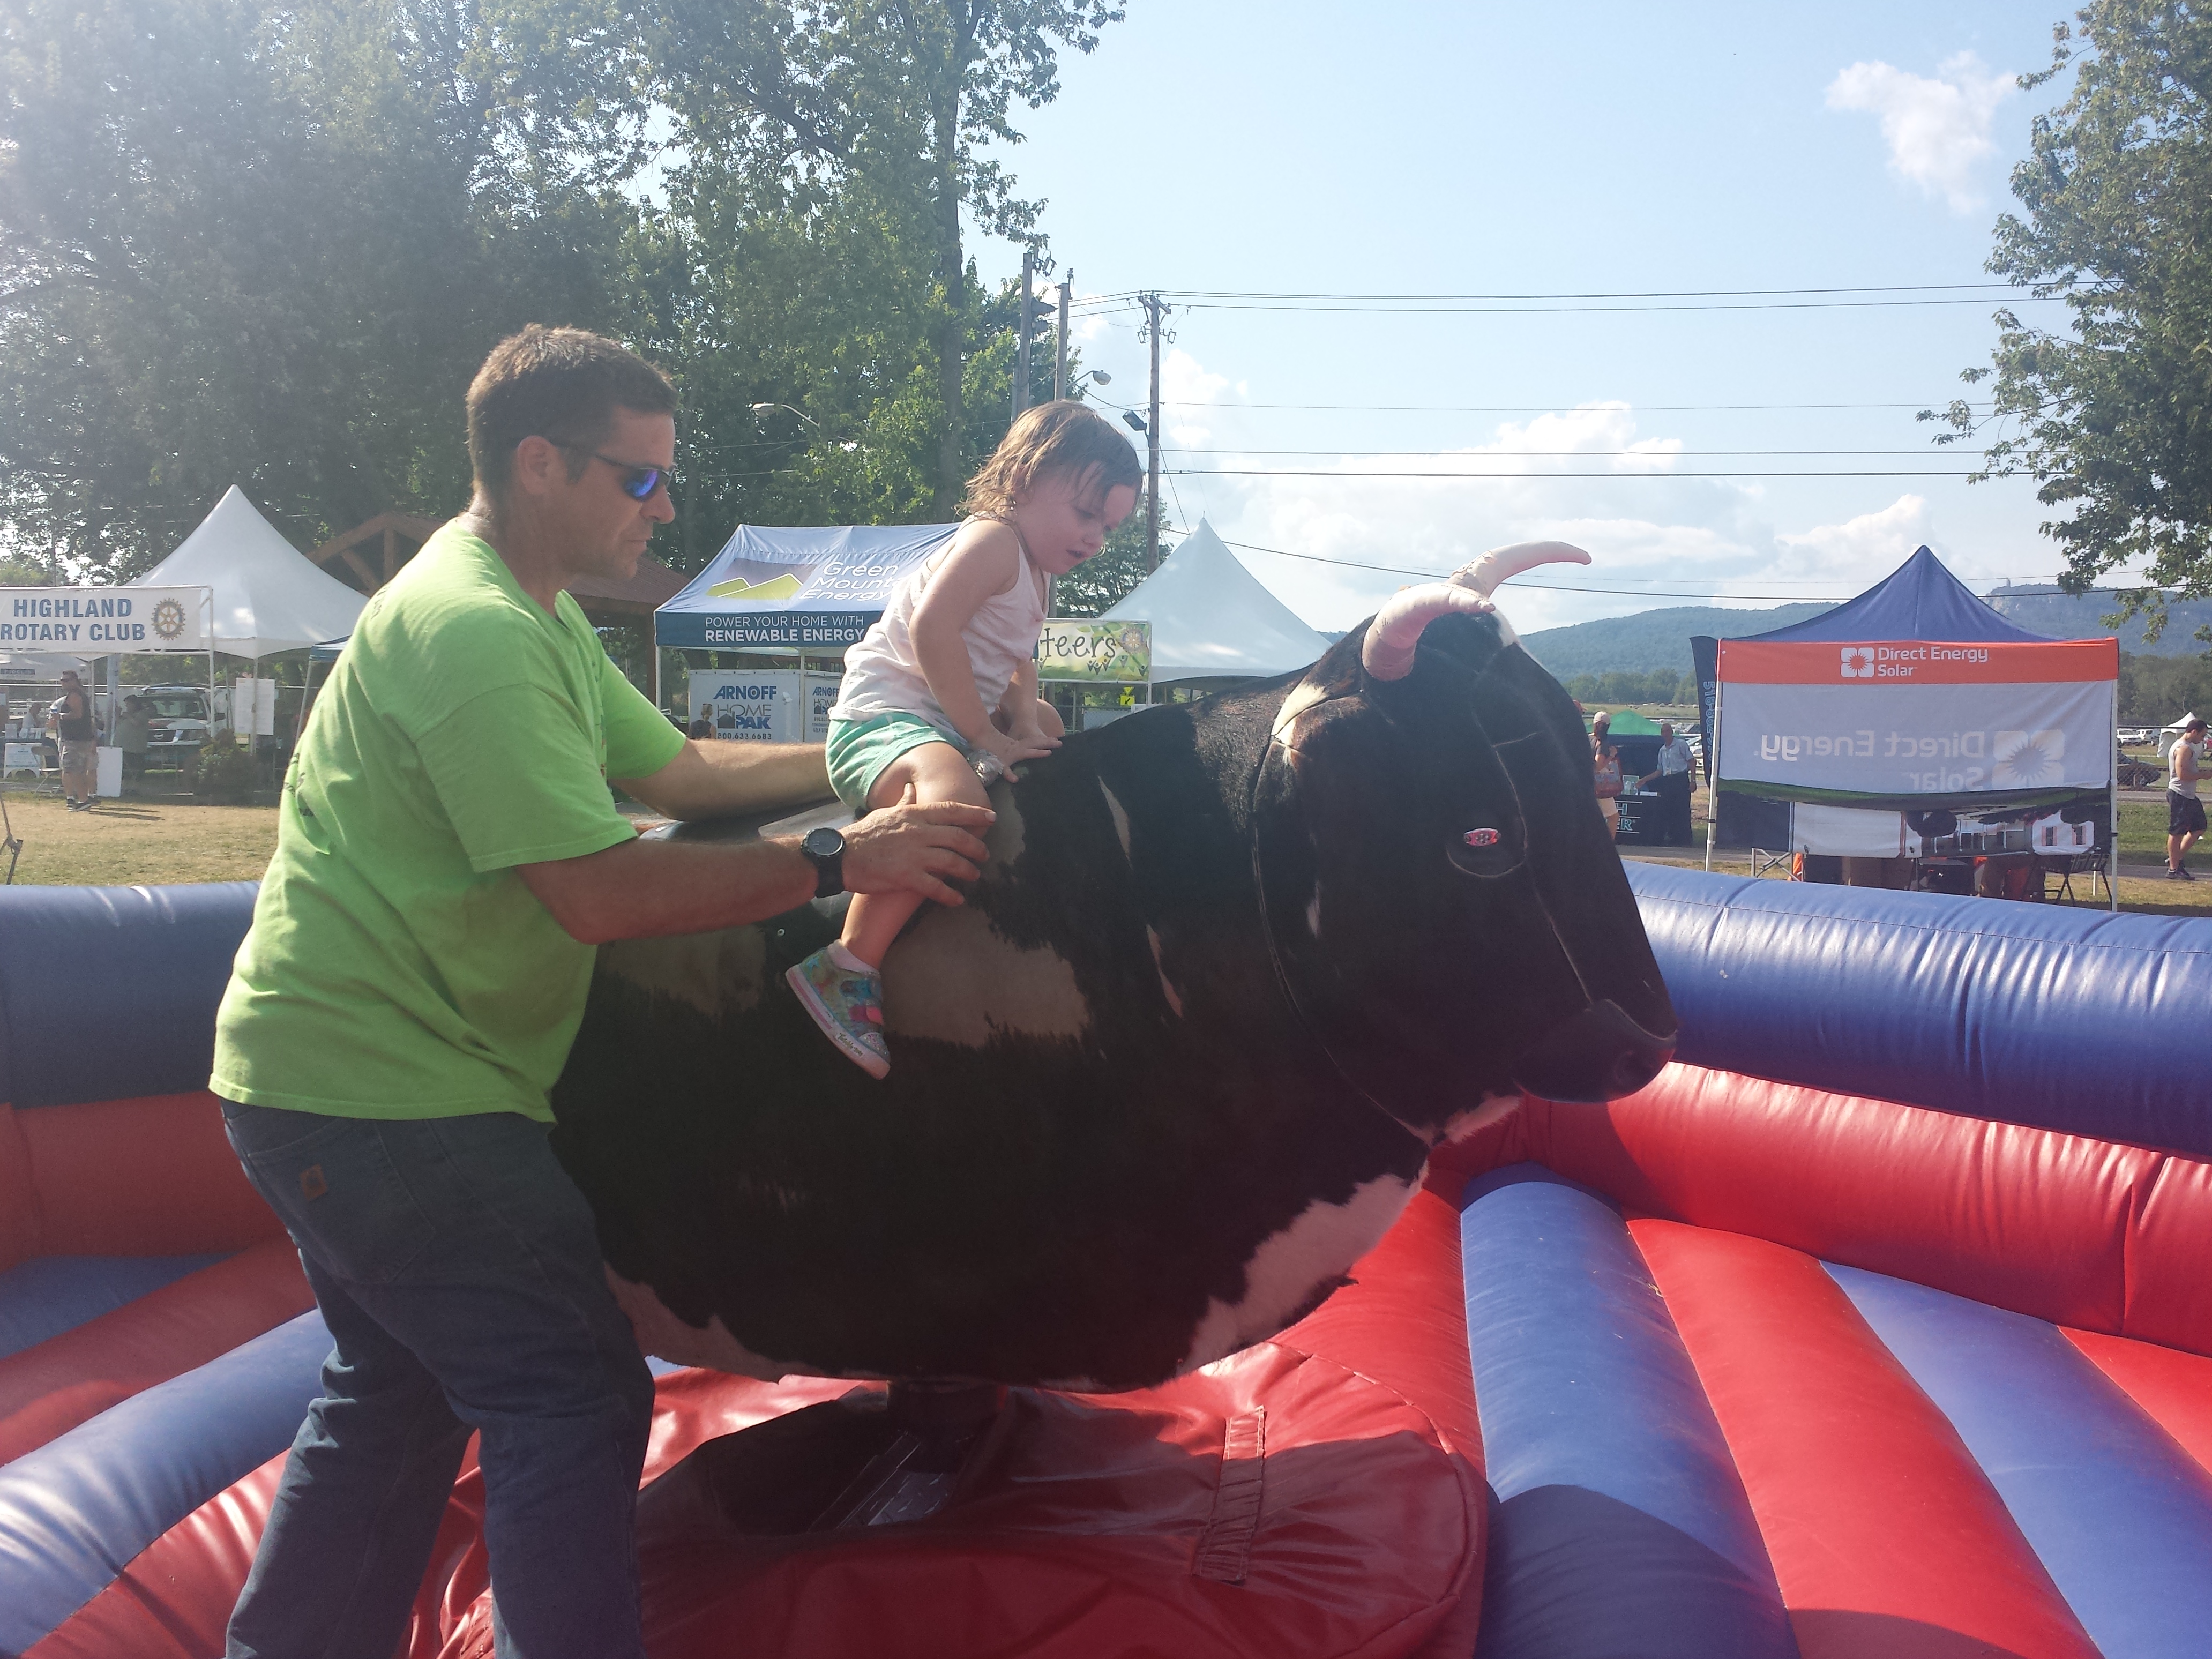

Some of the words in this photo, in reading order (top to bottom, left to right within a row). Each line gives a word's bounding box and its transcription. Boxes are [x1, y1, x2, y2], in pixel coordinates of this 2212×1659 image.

[823, 562, 898, 577] Green
[799, 589, 891, 601] Energy
[13, 599, 132, 617] HIGHLAND
[705, 617, 750, 627] POWER
[754, 616, 788, 626] YOUR
[792, 616, 828, 626] HOME
[832, 616, 864, 626] WITH
[1, 624, 81, 641] ROTARY
[89, 624, 145, 641] CLUB
[705, 629, 798, 642] RENEWABLE
[803, 628, 864, 641] ENERGY
[1878, 647, 1926, 660] Direct
[1931, 646, 1989, 663] Energy
[1878, 664, 1914, 676] Solar
[713, 685, 777, 700] ARNOFF
[812, 686, 839, 697] ARNOFF
[717, 704, 772, 717] HOME
[736, 716, 772, 729] PAK
